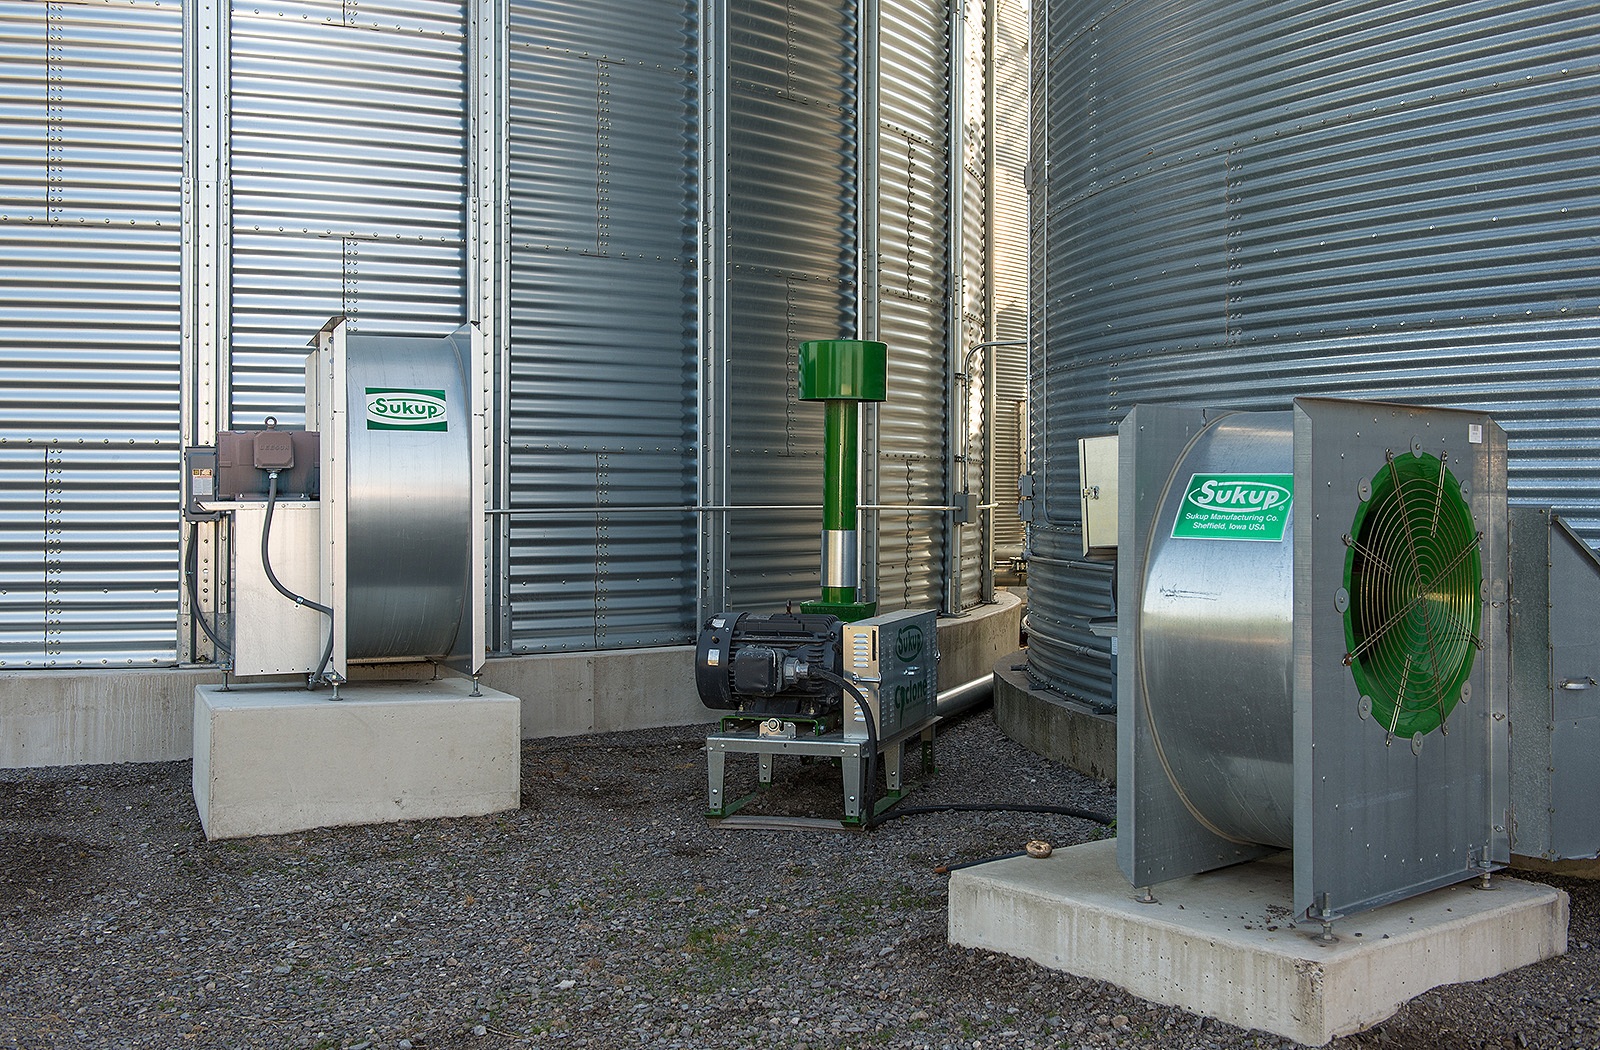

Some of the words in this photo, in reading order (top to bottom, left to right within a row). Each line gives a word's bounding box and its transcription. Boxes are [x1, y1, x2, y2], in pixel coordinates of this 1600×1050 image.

[375, 397, 438, 419] Sukup
[1197, 480, 1280, 510] Sukup
[1185, 512, 1209, 521] Sukup
[1210, 513, 1264, 523] Manufacturing
[1266, 514, 1279, 522] Co.
[1193, 522, 1227, 531] Sheffield,
[1229, 523, 1247, 531] Iowa
[1248, 523, 1266, 531] USA
[897, 627, 921, 655] Sukup
